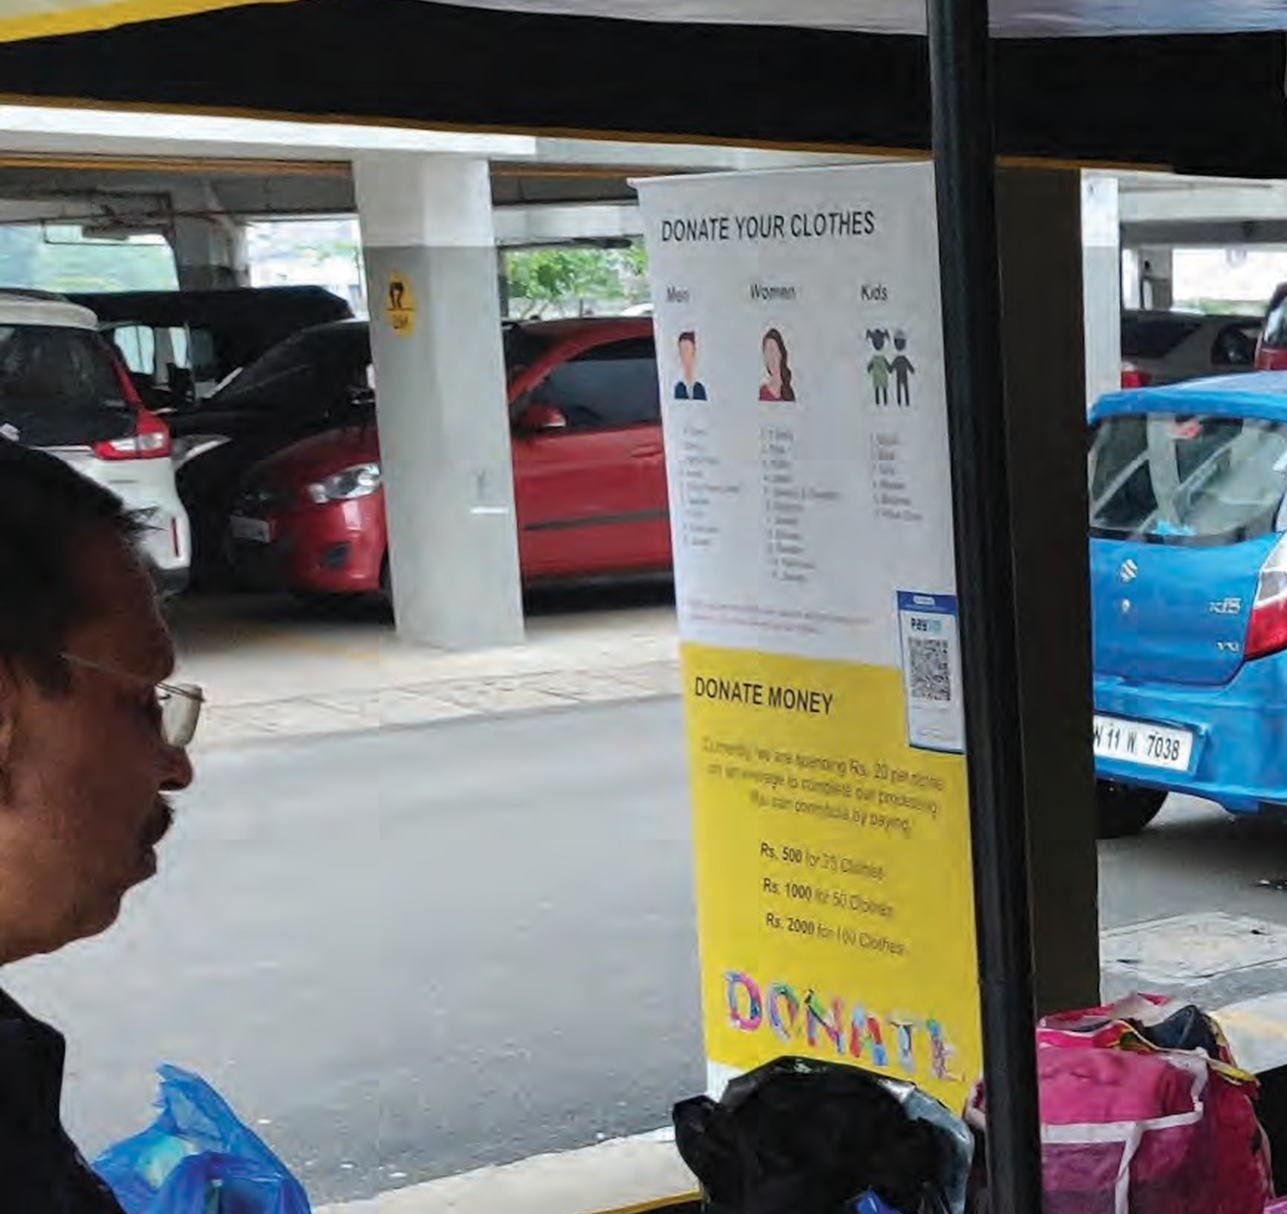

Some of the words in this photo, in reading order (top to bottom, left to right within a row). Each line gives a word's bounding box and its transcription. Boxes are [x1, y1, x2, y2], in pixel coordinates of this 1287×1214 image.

[661, 217, 730, 242] DONATE
[735, 213, 785, 239] YOUR
[790, 210, 875, 237] CLOTHES
[666, 287, 690, 302] Men
[750, 284, 796, 300] Women
[861, 284, 888, 301] Kids
[695, 676, 763, 705] DONATE
[768, 687, 834, 714] MONEY
[1147, 734, 1180, 761] 7038
[875, 762, 889, 779] 20
[852, 809, 867, 826] by
[760, 842, 778, 860] Rs.
[782, 846, 803, 864] 500
[806, 847, 820, 867] for
[763, 877, 780, 895] Rs.
[785, 882, 812, 901] 1000
[815, 887, 830, 904] for
[833, 891, 847, 909] 50
[766, 912, 783, 929] Rs.
[787, 917, 815, 935] 2000
[817, 922, 834, 939] for
[837, 926, 857, 946] 100
[859, 932, 905, 955] Clothes
